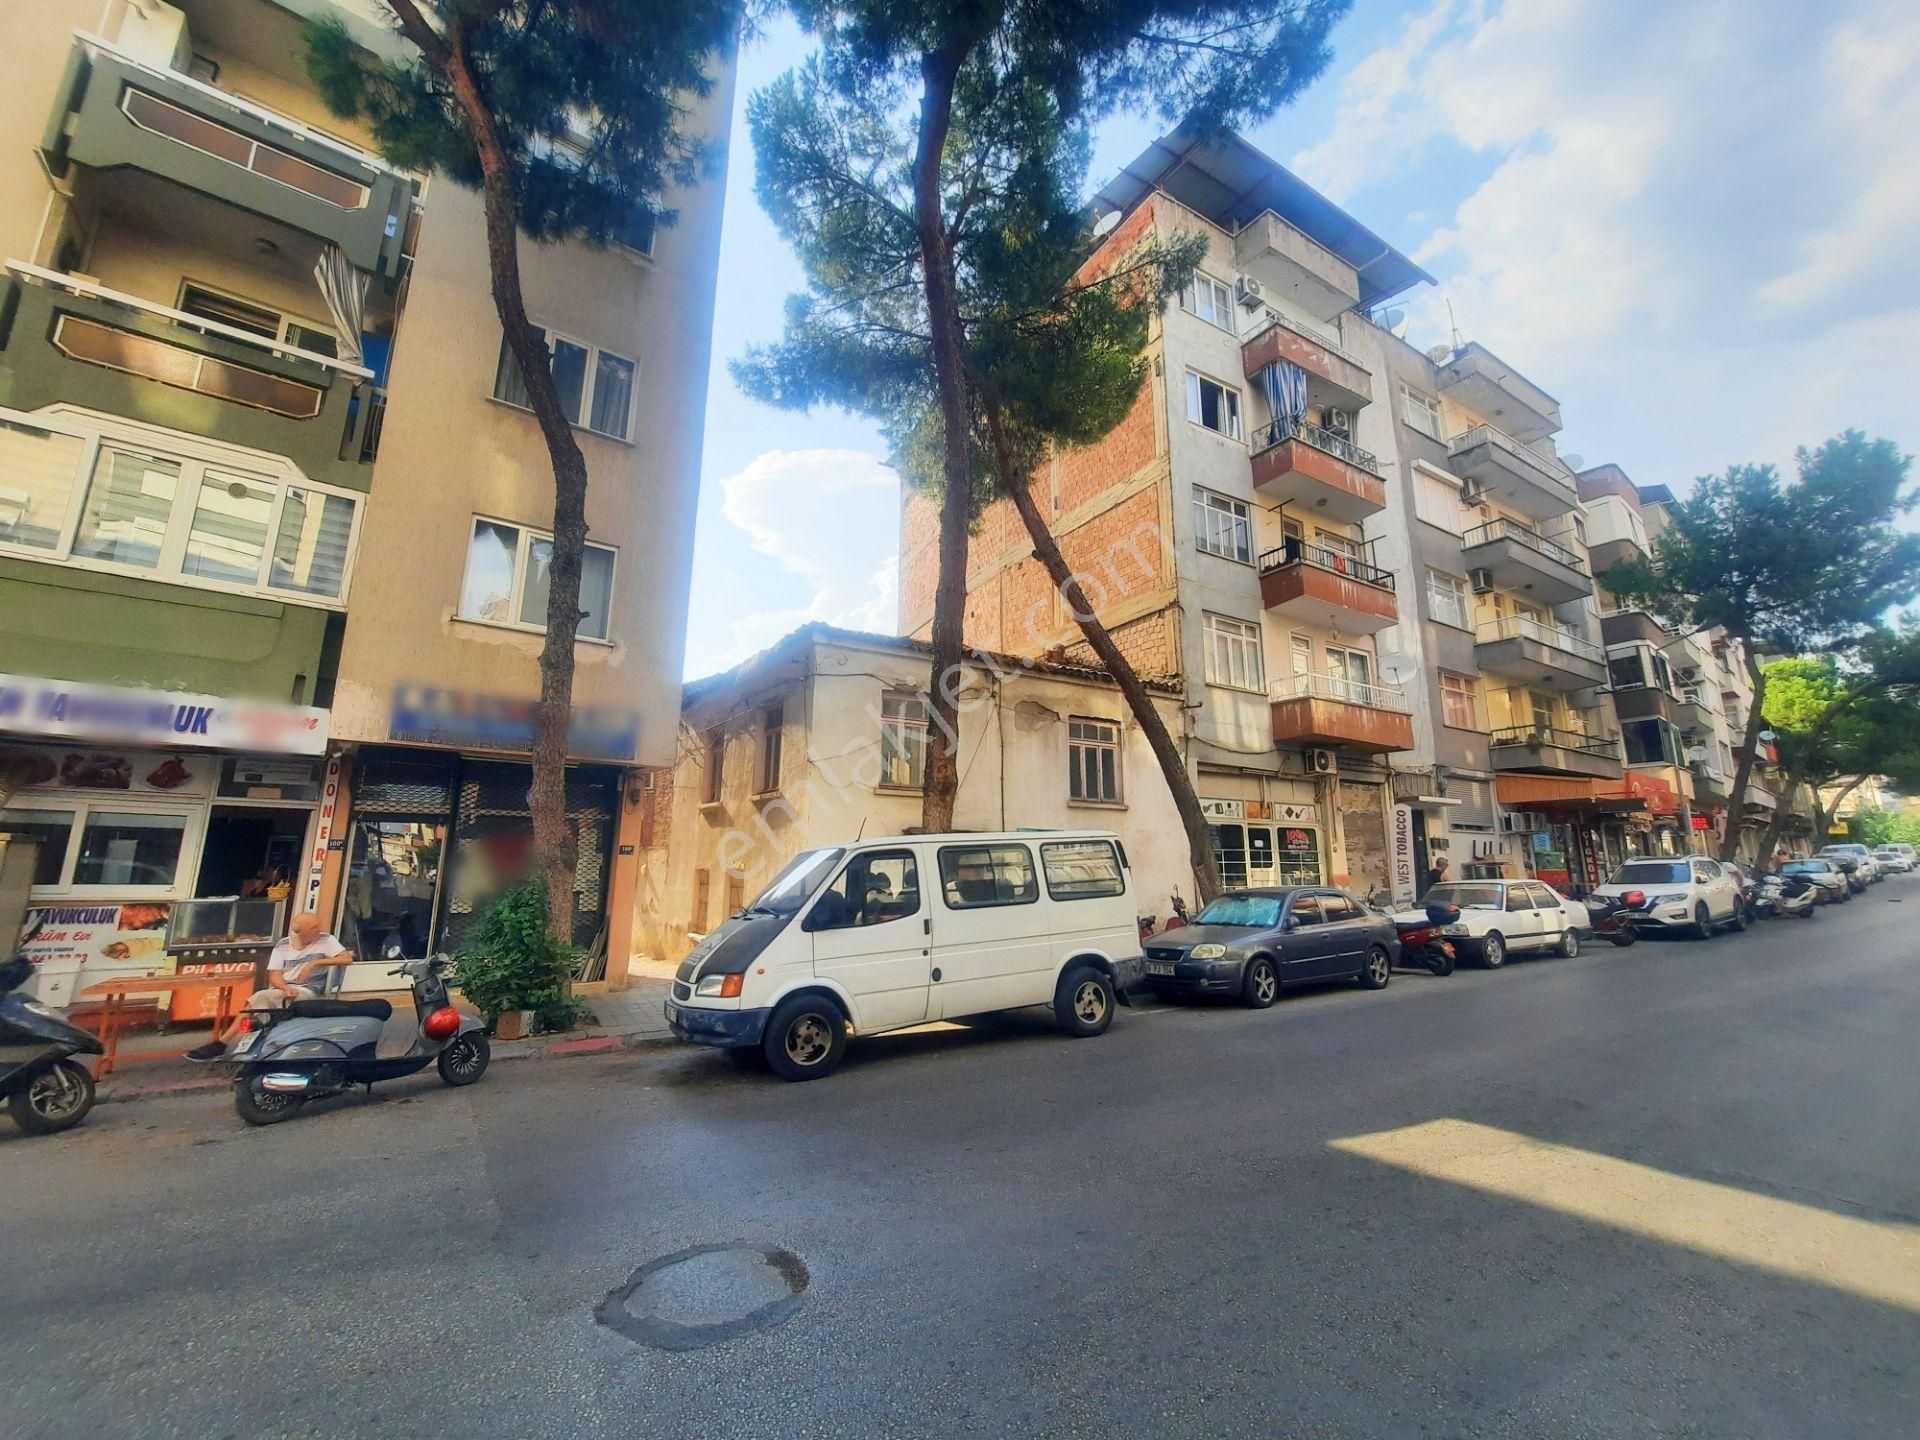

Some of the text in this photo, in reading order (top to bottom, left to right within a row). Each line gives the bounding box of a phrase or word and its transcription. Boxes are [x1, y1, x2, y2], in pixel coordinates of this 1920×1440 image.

[315, 762, 338, 861] DÖNER
[1396, 809, 1408, 856] TOBACCO
[1397, 858, 1410, 885] WEST
